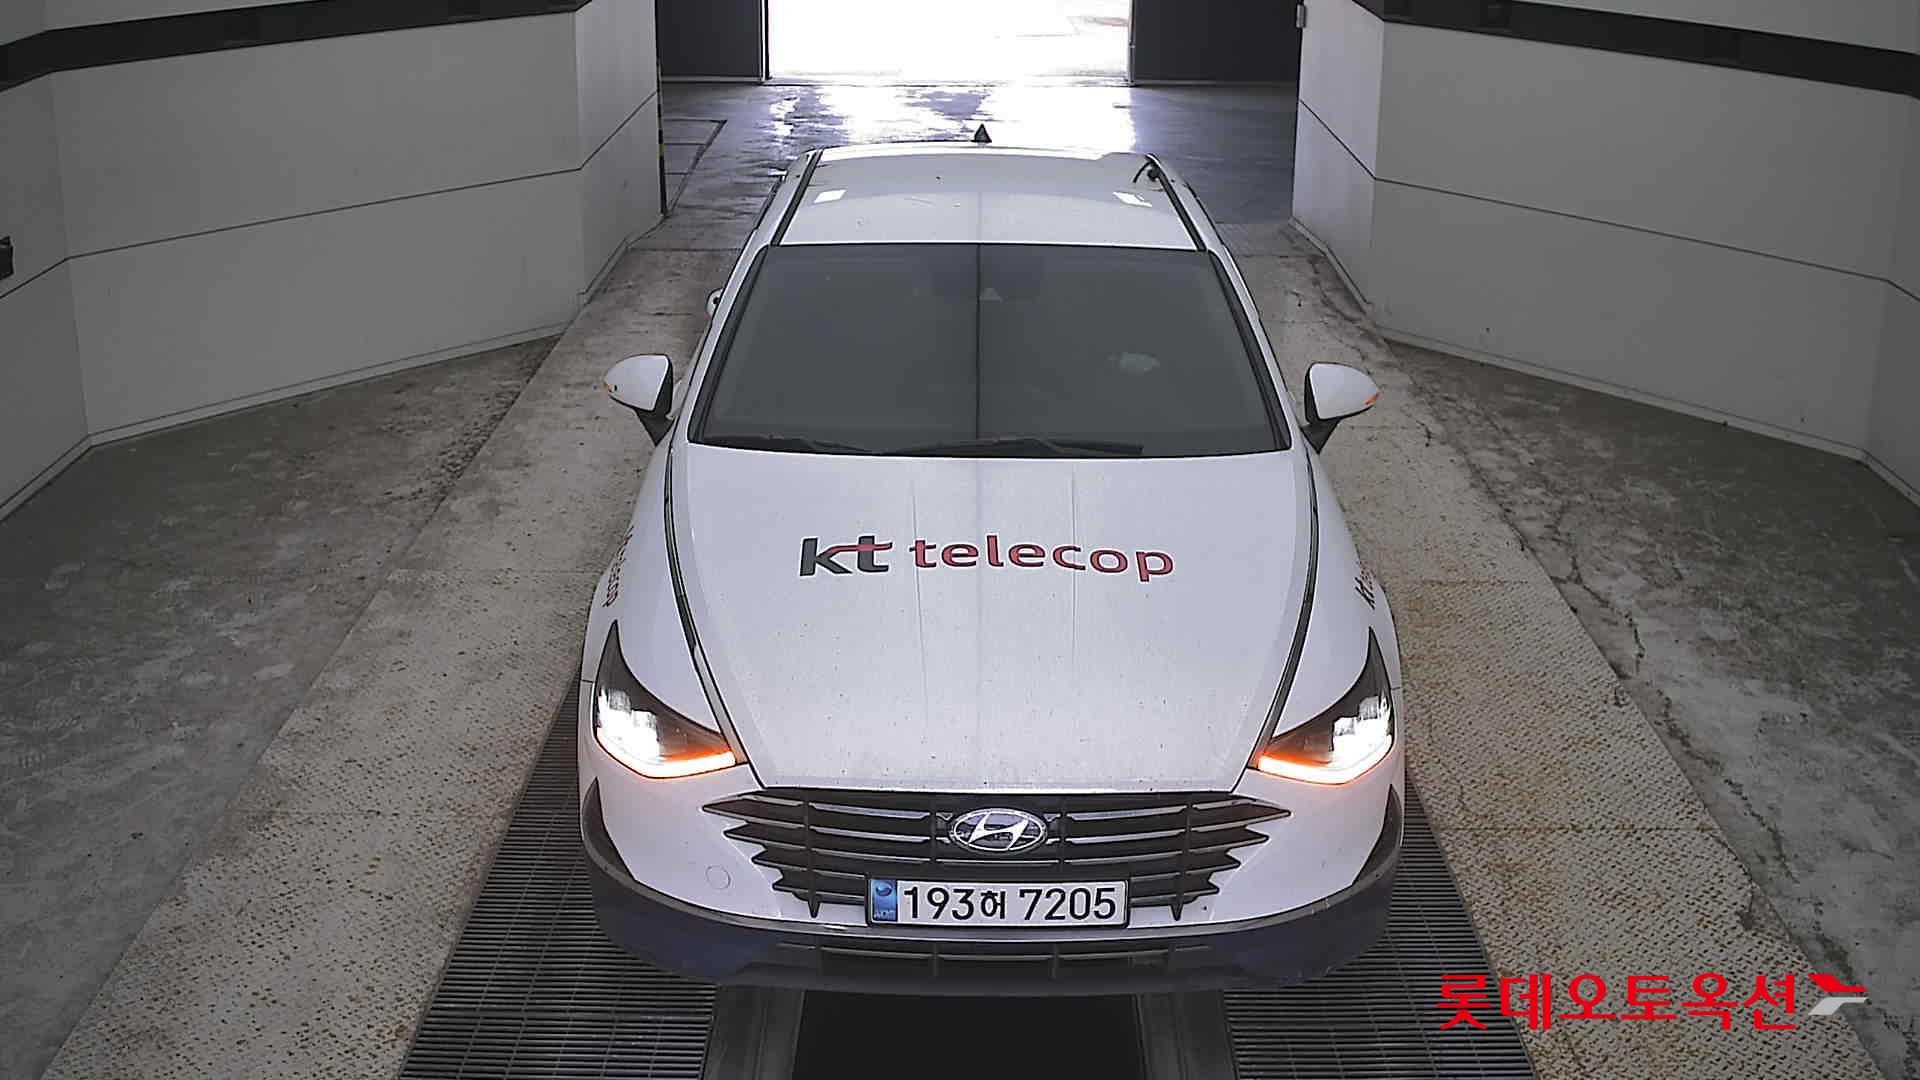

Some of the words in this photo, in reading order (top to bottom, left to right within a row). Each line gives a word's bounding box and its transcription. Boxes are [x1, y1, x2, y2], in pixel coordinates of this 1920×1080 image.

[799, 534, 893, 577] kt
[909, 534, 1174, 583] telecop
[903, 885, 1006, 921] 193허
[1018, 887, 1117, 921] 7205
